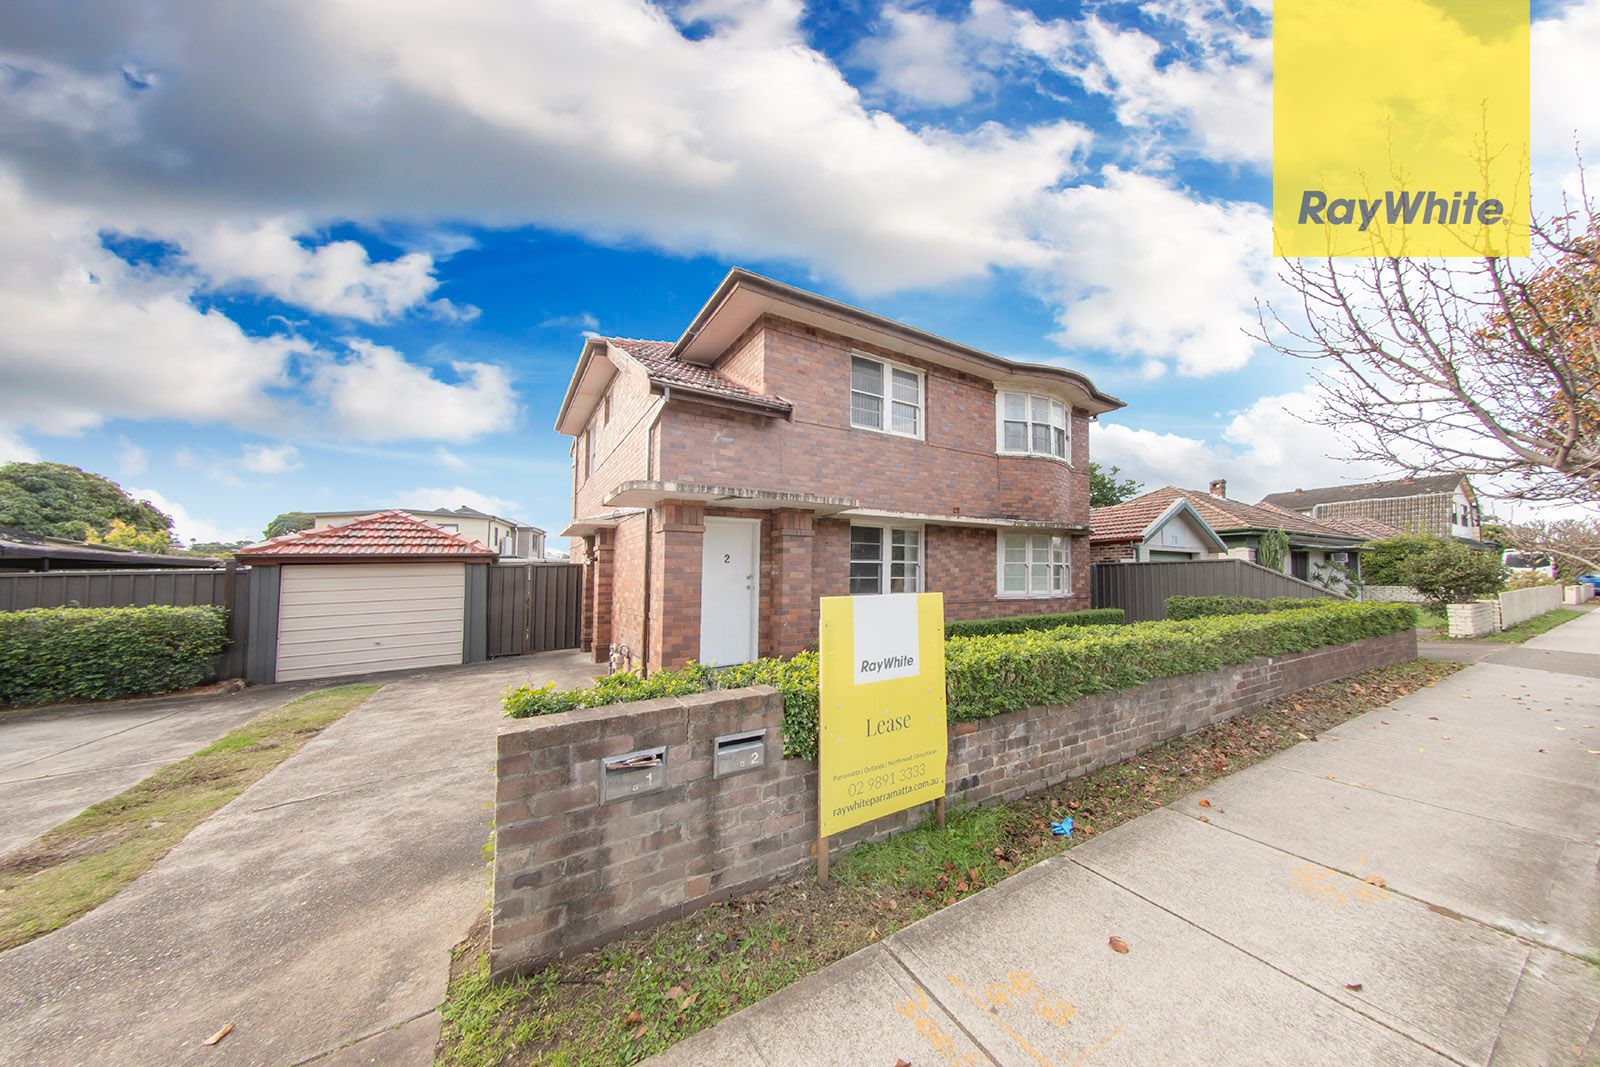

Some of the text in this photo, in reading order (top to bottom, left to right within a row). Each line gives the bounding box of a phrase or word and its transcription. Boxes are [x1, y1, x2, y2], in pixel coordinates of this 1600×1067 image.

[724, 553, 730, 564] 2
[861, 655, 914, 673] RayWhite
[866, 714, 911, 737] Lease
[751, 752, 759, 765] 2
[645, 773, 652, 786] 1
[848, 763, 926, 797] 02 9891 3333
[832, 777, 939, 816] raywhiteparramatta.com.au
